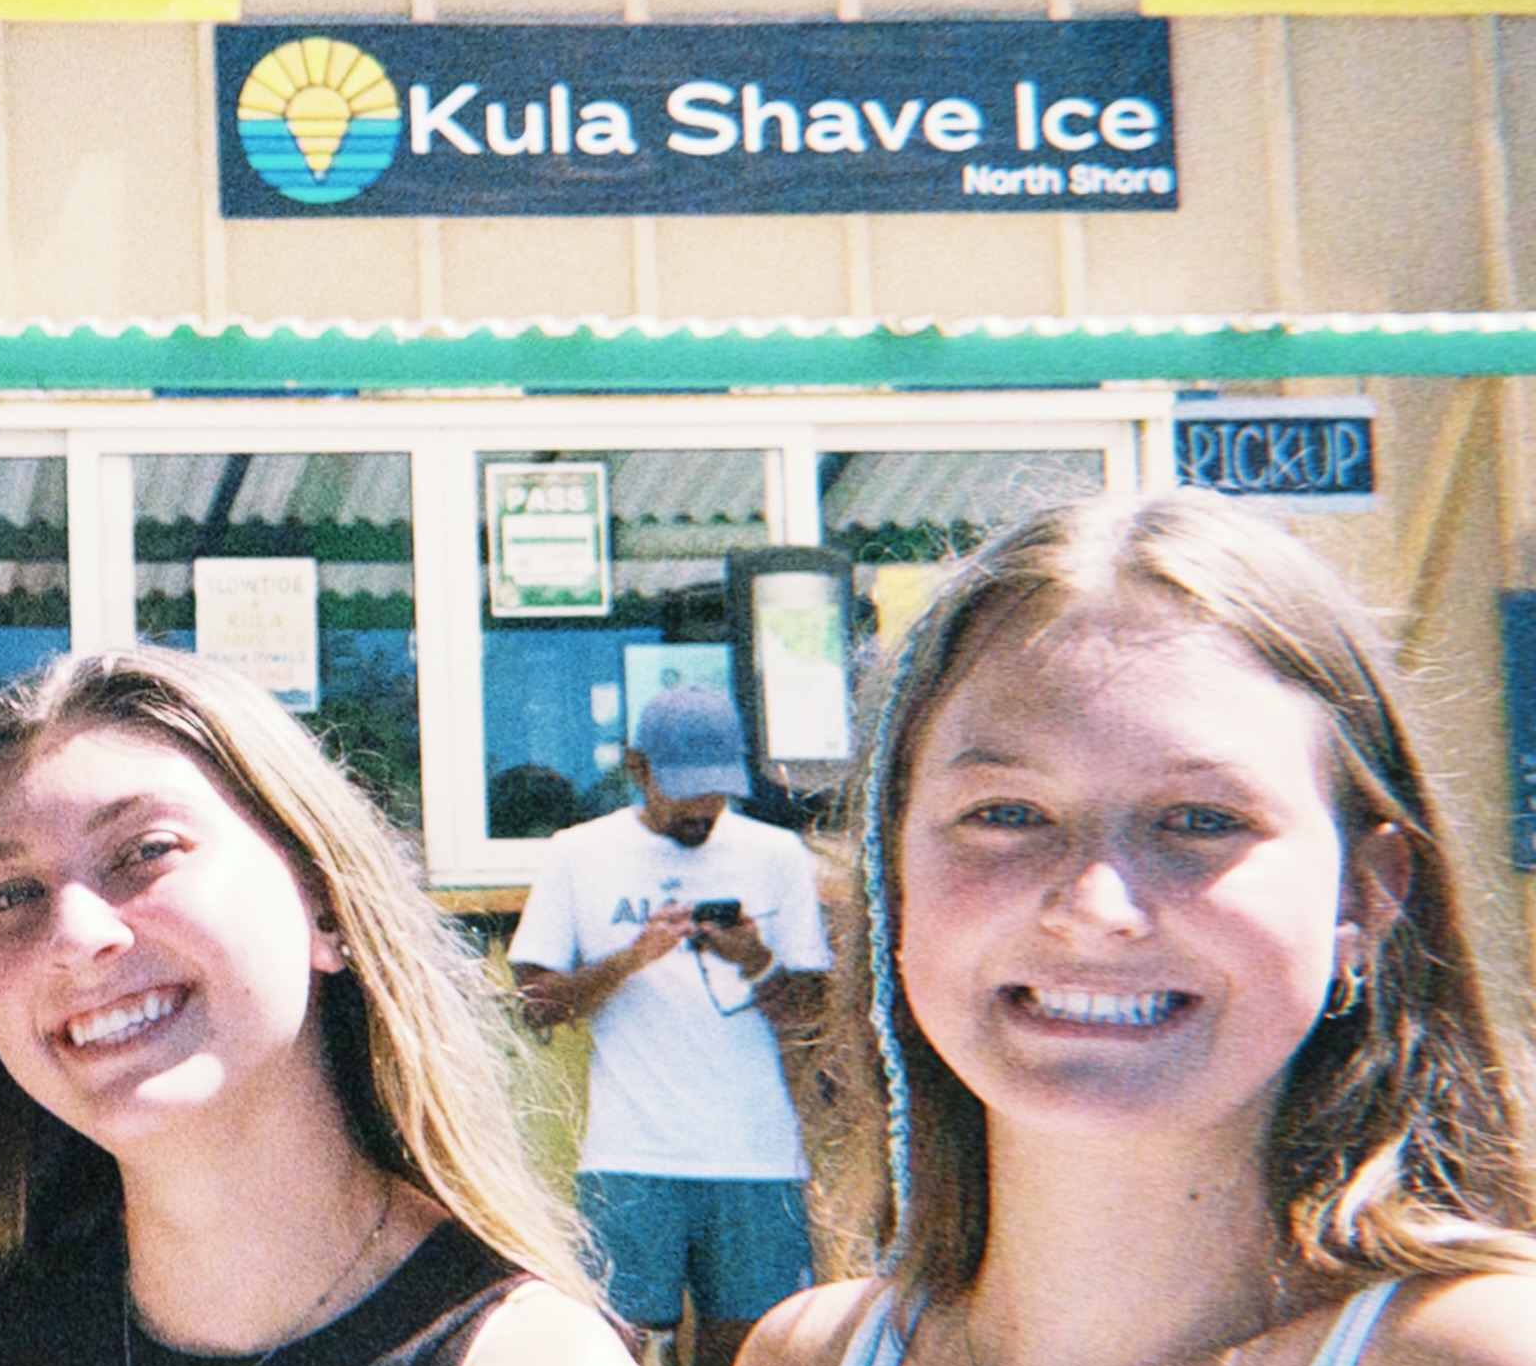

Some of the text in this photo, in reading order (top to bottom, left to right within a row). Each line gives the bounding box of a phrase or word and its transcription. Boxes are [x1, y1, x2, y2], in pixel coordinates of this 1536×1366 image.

[407, 80, 1160, 155] Kula Shave Ice
[962, 164, 1174, 195] North Shore
[1186, 422, 1364, 487] PICKUP
[505, 486, 587, 512] PASS
